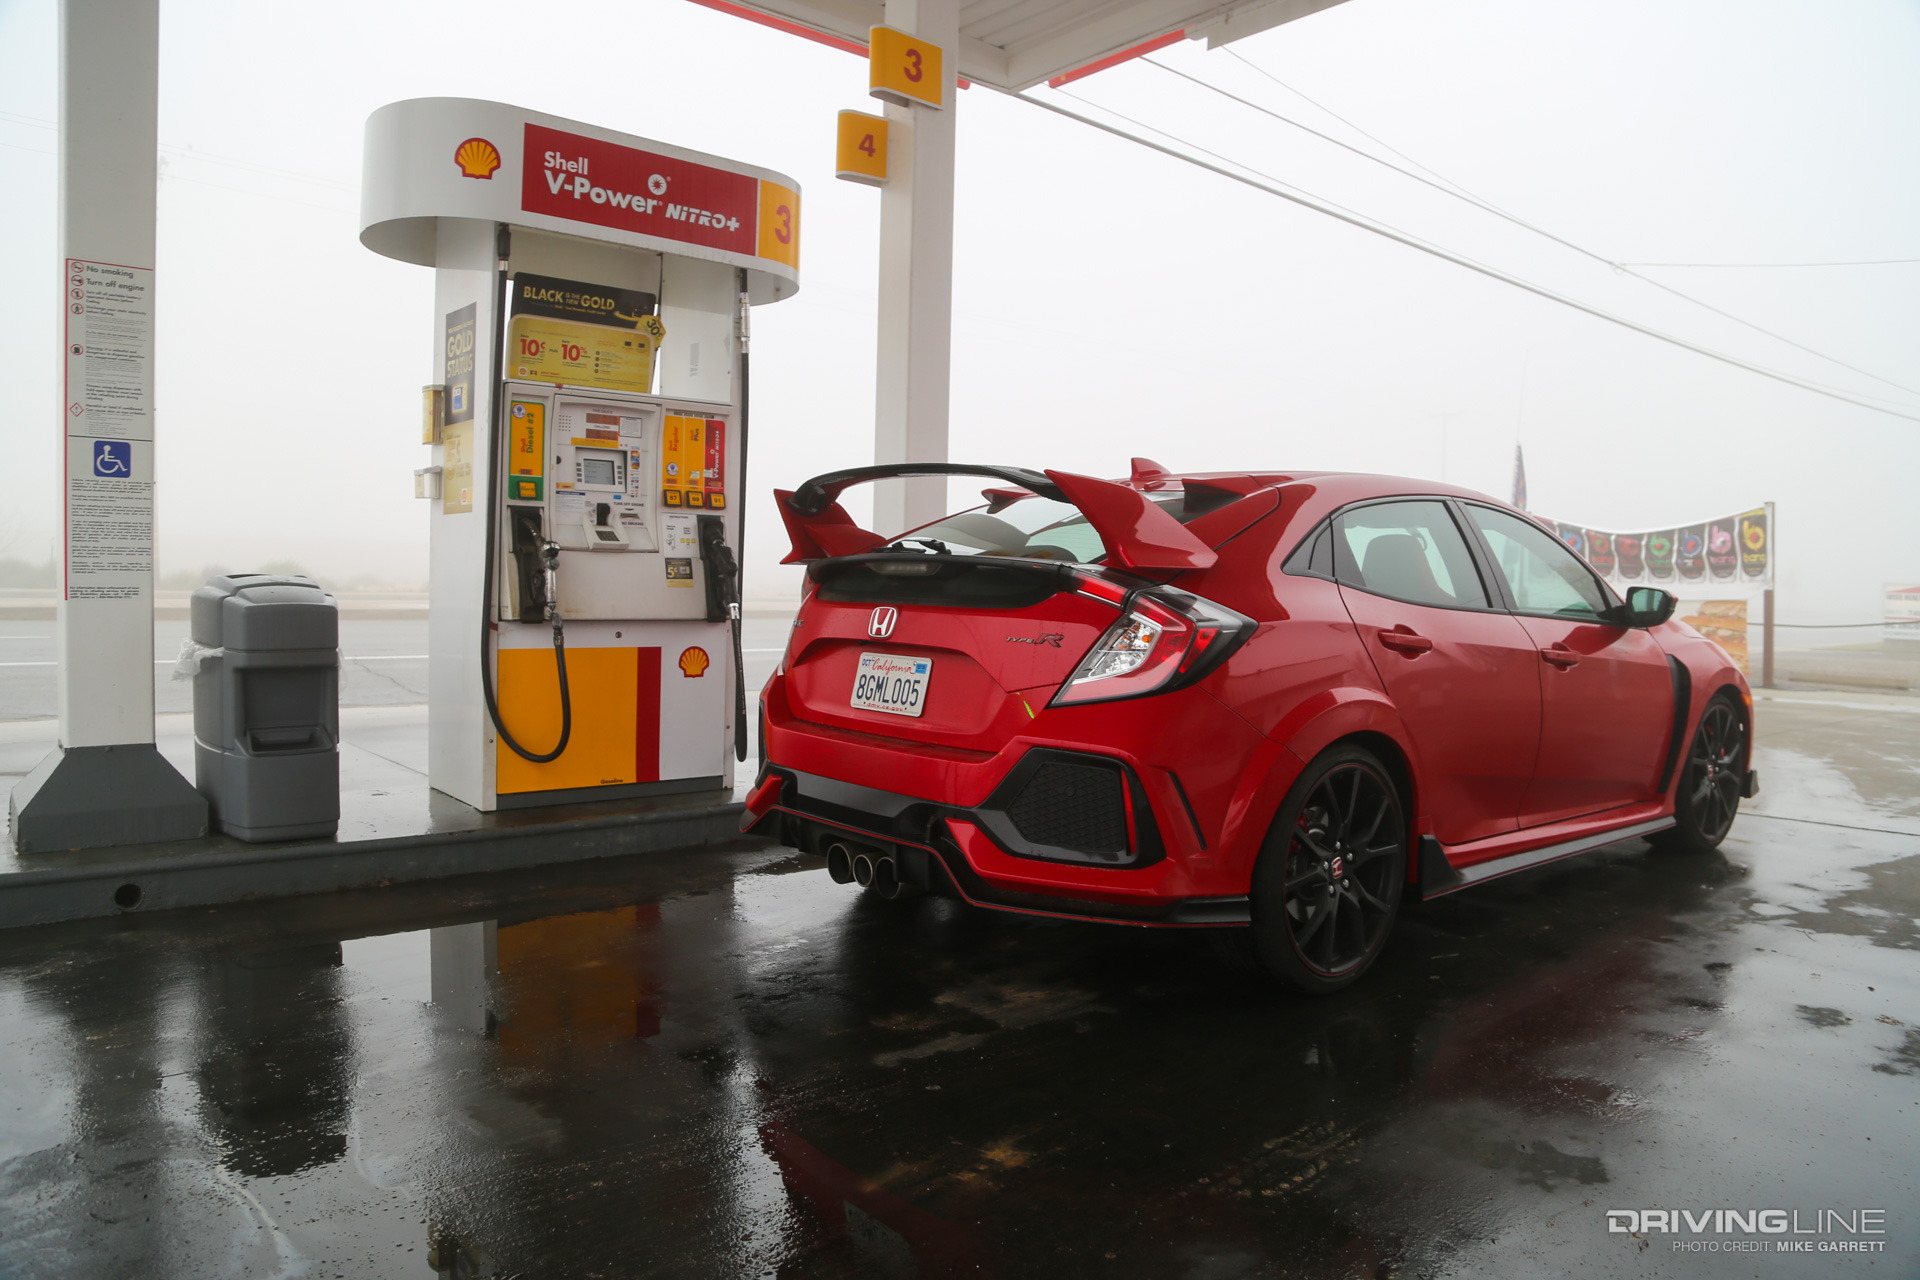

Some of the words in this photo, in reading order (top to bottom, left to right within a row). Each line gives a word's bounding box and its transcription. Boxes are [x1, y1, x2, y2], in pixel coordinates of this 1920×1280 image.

[904, 48, 922, 82] 3
[858, 134, 876, 157] 4
[544, 151, 588, 175] Shell
[544, 170, 658, 214] V-Power
[775, 205, 791, 244] 3
[101, 268, 134, 279] smoking
[524, 286, 564, 303] BLACK
[580, 295, 615, 310] GOLD
[448, 330, 473, 358] GOLD
[447, 353, 473, 378] STATUS
[527, 412, 534, 424] #2
[1034, 632, 1064, 648] R
[872, 658, 916, 675] California
[856, 674, 920, 706] 8GML005
[867, 702, 903, 711] dmv.ca.gov
